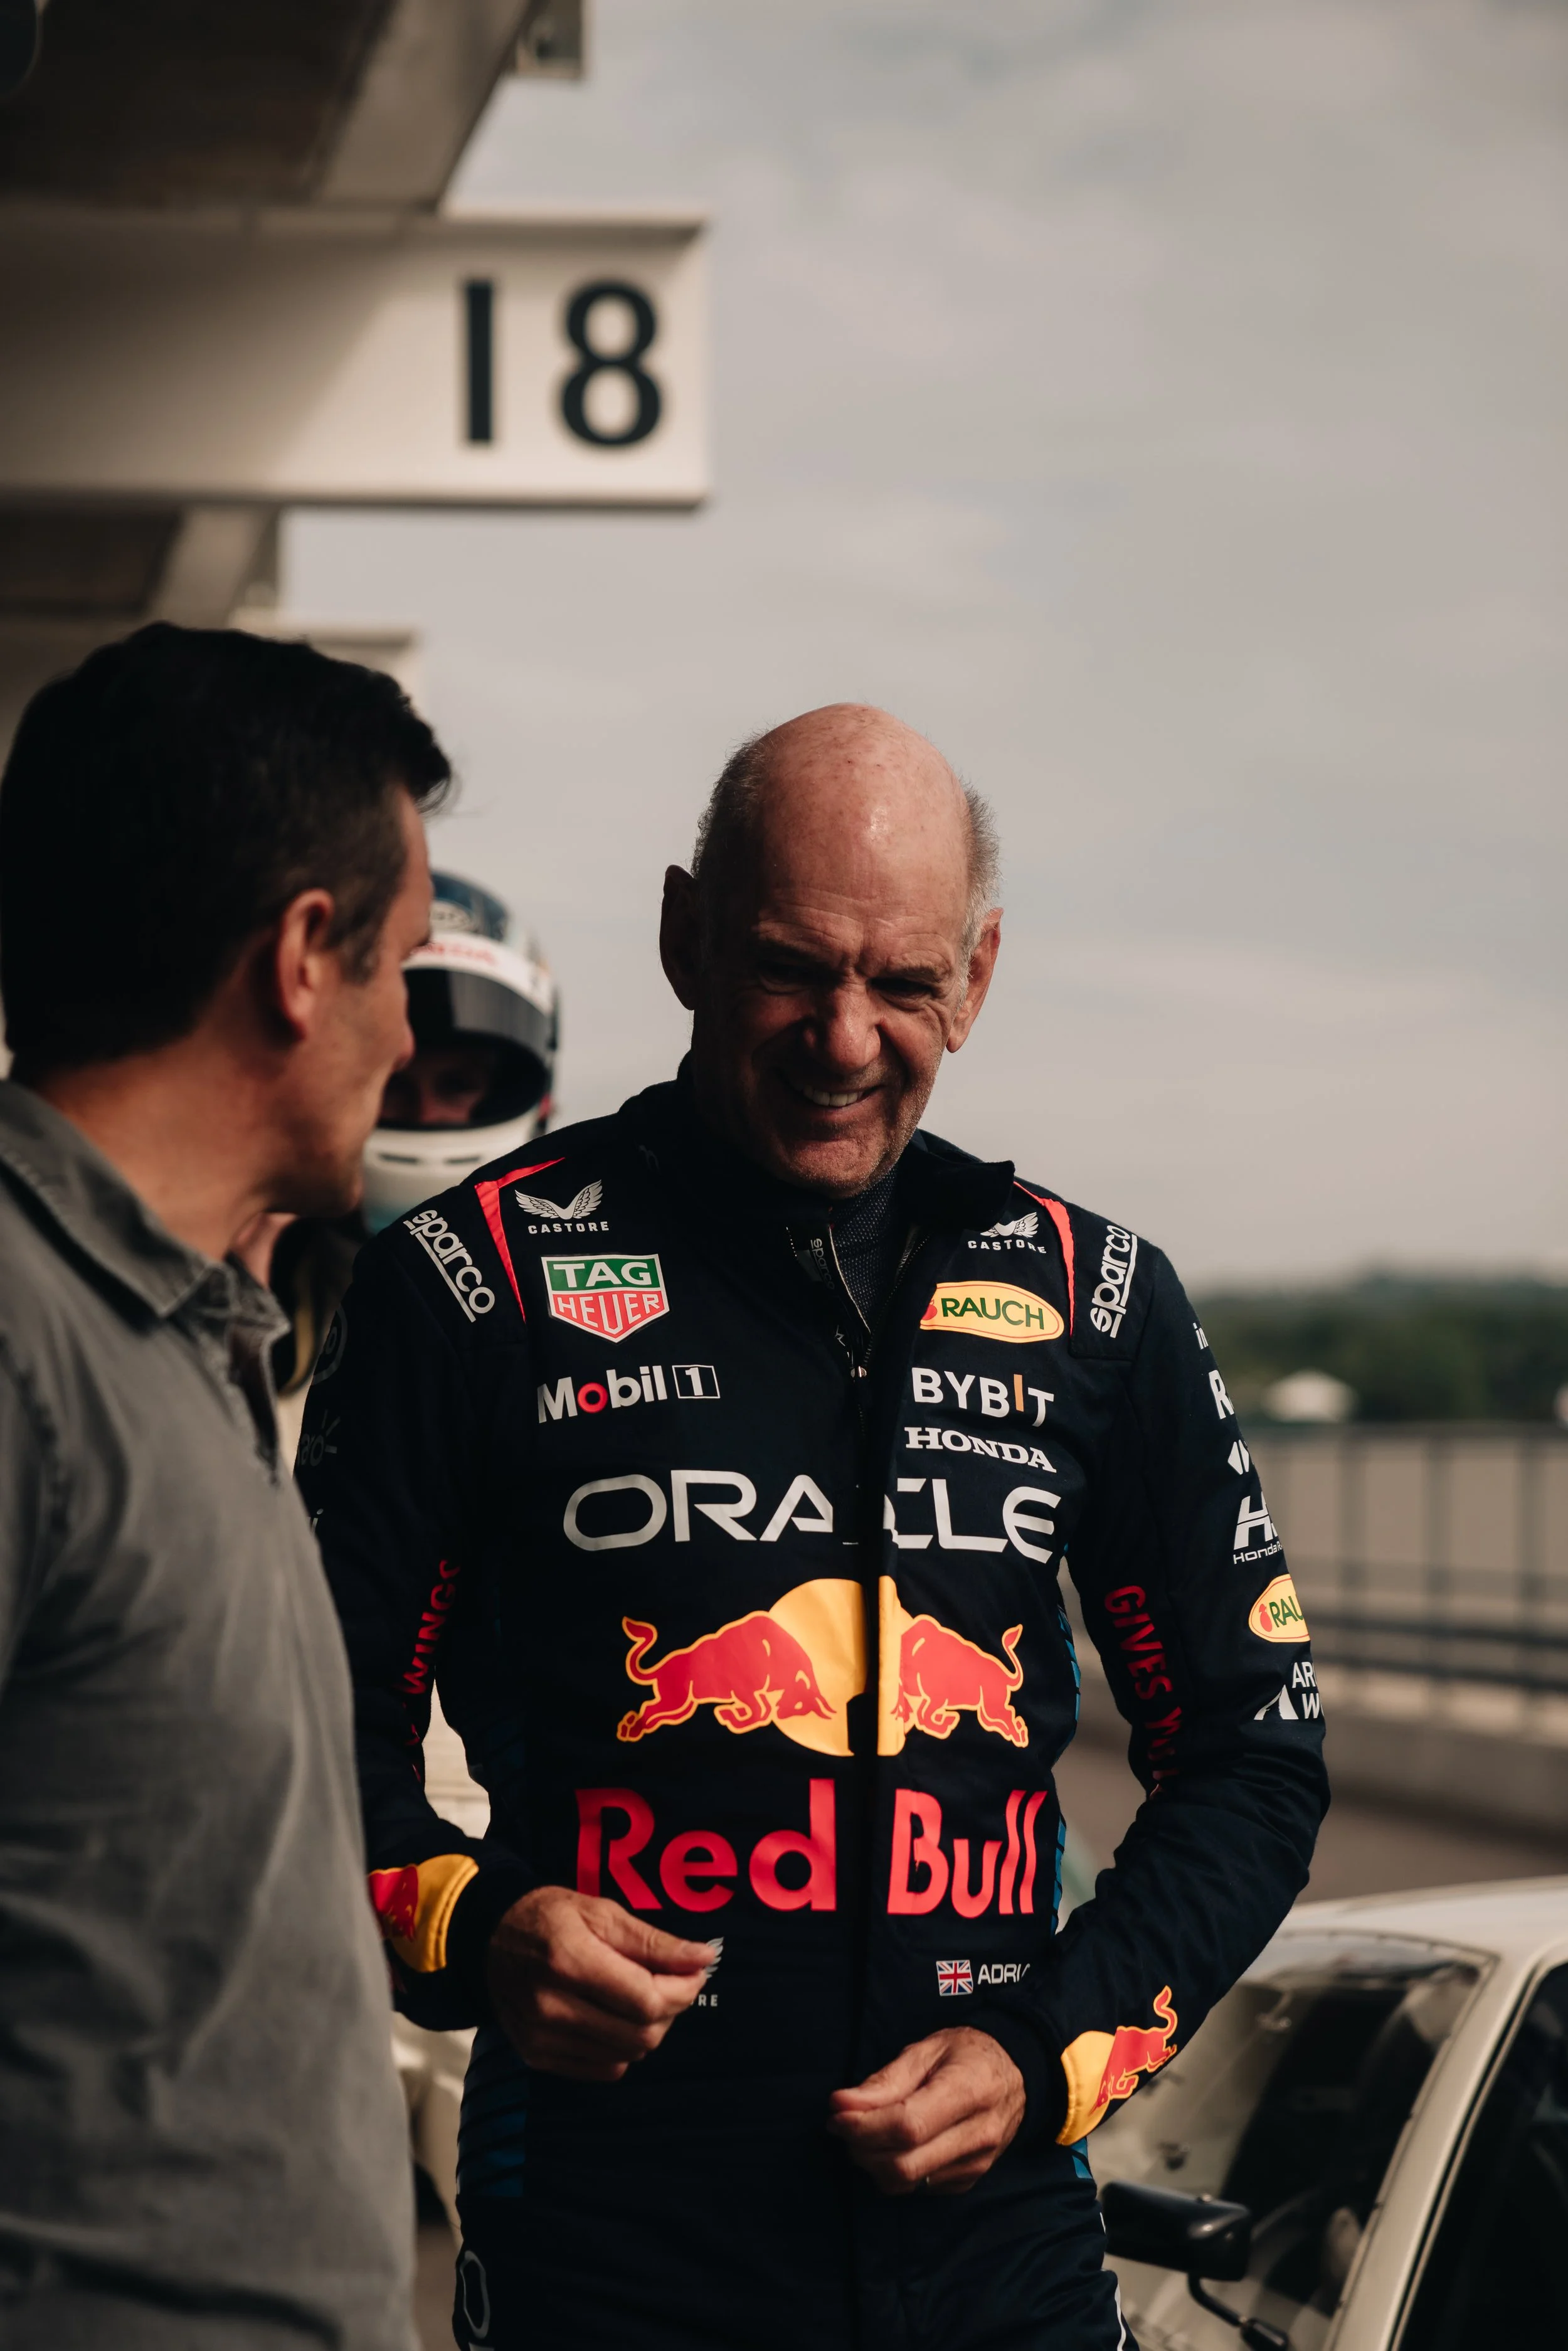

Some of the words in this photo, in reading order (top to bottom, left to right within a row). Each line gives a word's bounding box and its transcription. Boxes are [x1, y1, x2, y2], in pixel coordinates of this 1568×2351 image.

[465, 279, 662, 447] 18
[528, 1221, 610, 1234] CASTORE
[968, 1239, 1047, 1254] CASTORE
[403, 1209, 495, 1319] sparco
[553, 1261, 652, 1288] TAG
[1090, 1224, 1131, 1334] sparco
[556, 1293, 660, 1335] HEUER
[941, 1297, 1044, 1330] RAUCH
[538, 1365, 668, 1423] Mobil
[911, 1367, 1055, 1428] BYBIT
[904, 1427, 1057, 1473] HONDA
[1233, 1543, 1278, 1564] Honda
[1104, 1584, 1173, 1700] GIVES
[1292, 1661, 1318, 1689] AR
[575, 1778, 837, 1911] Red
[886, 1788, 1047, 1919] Bull
